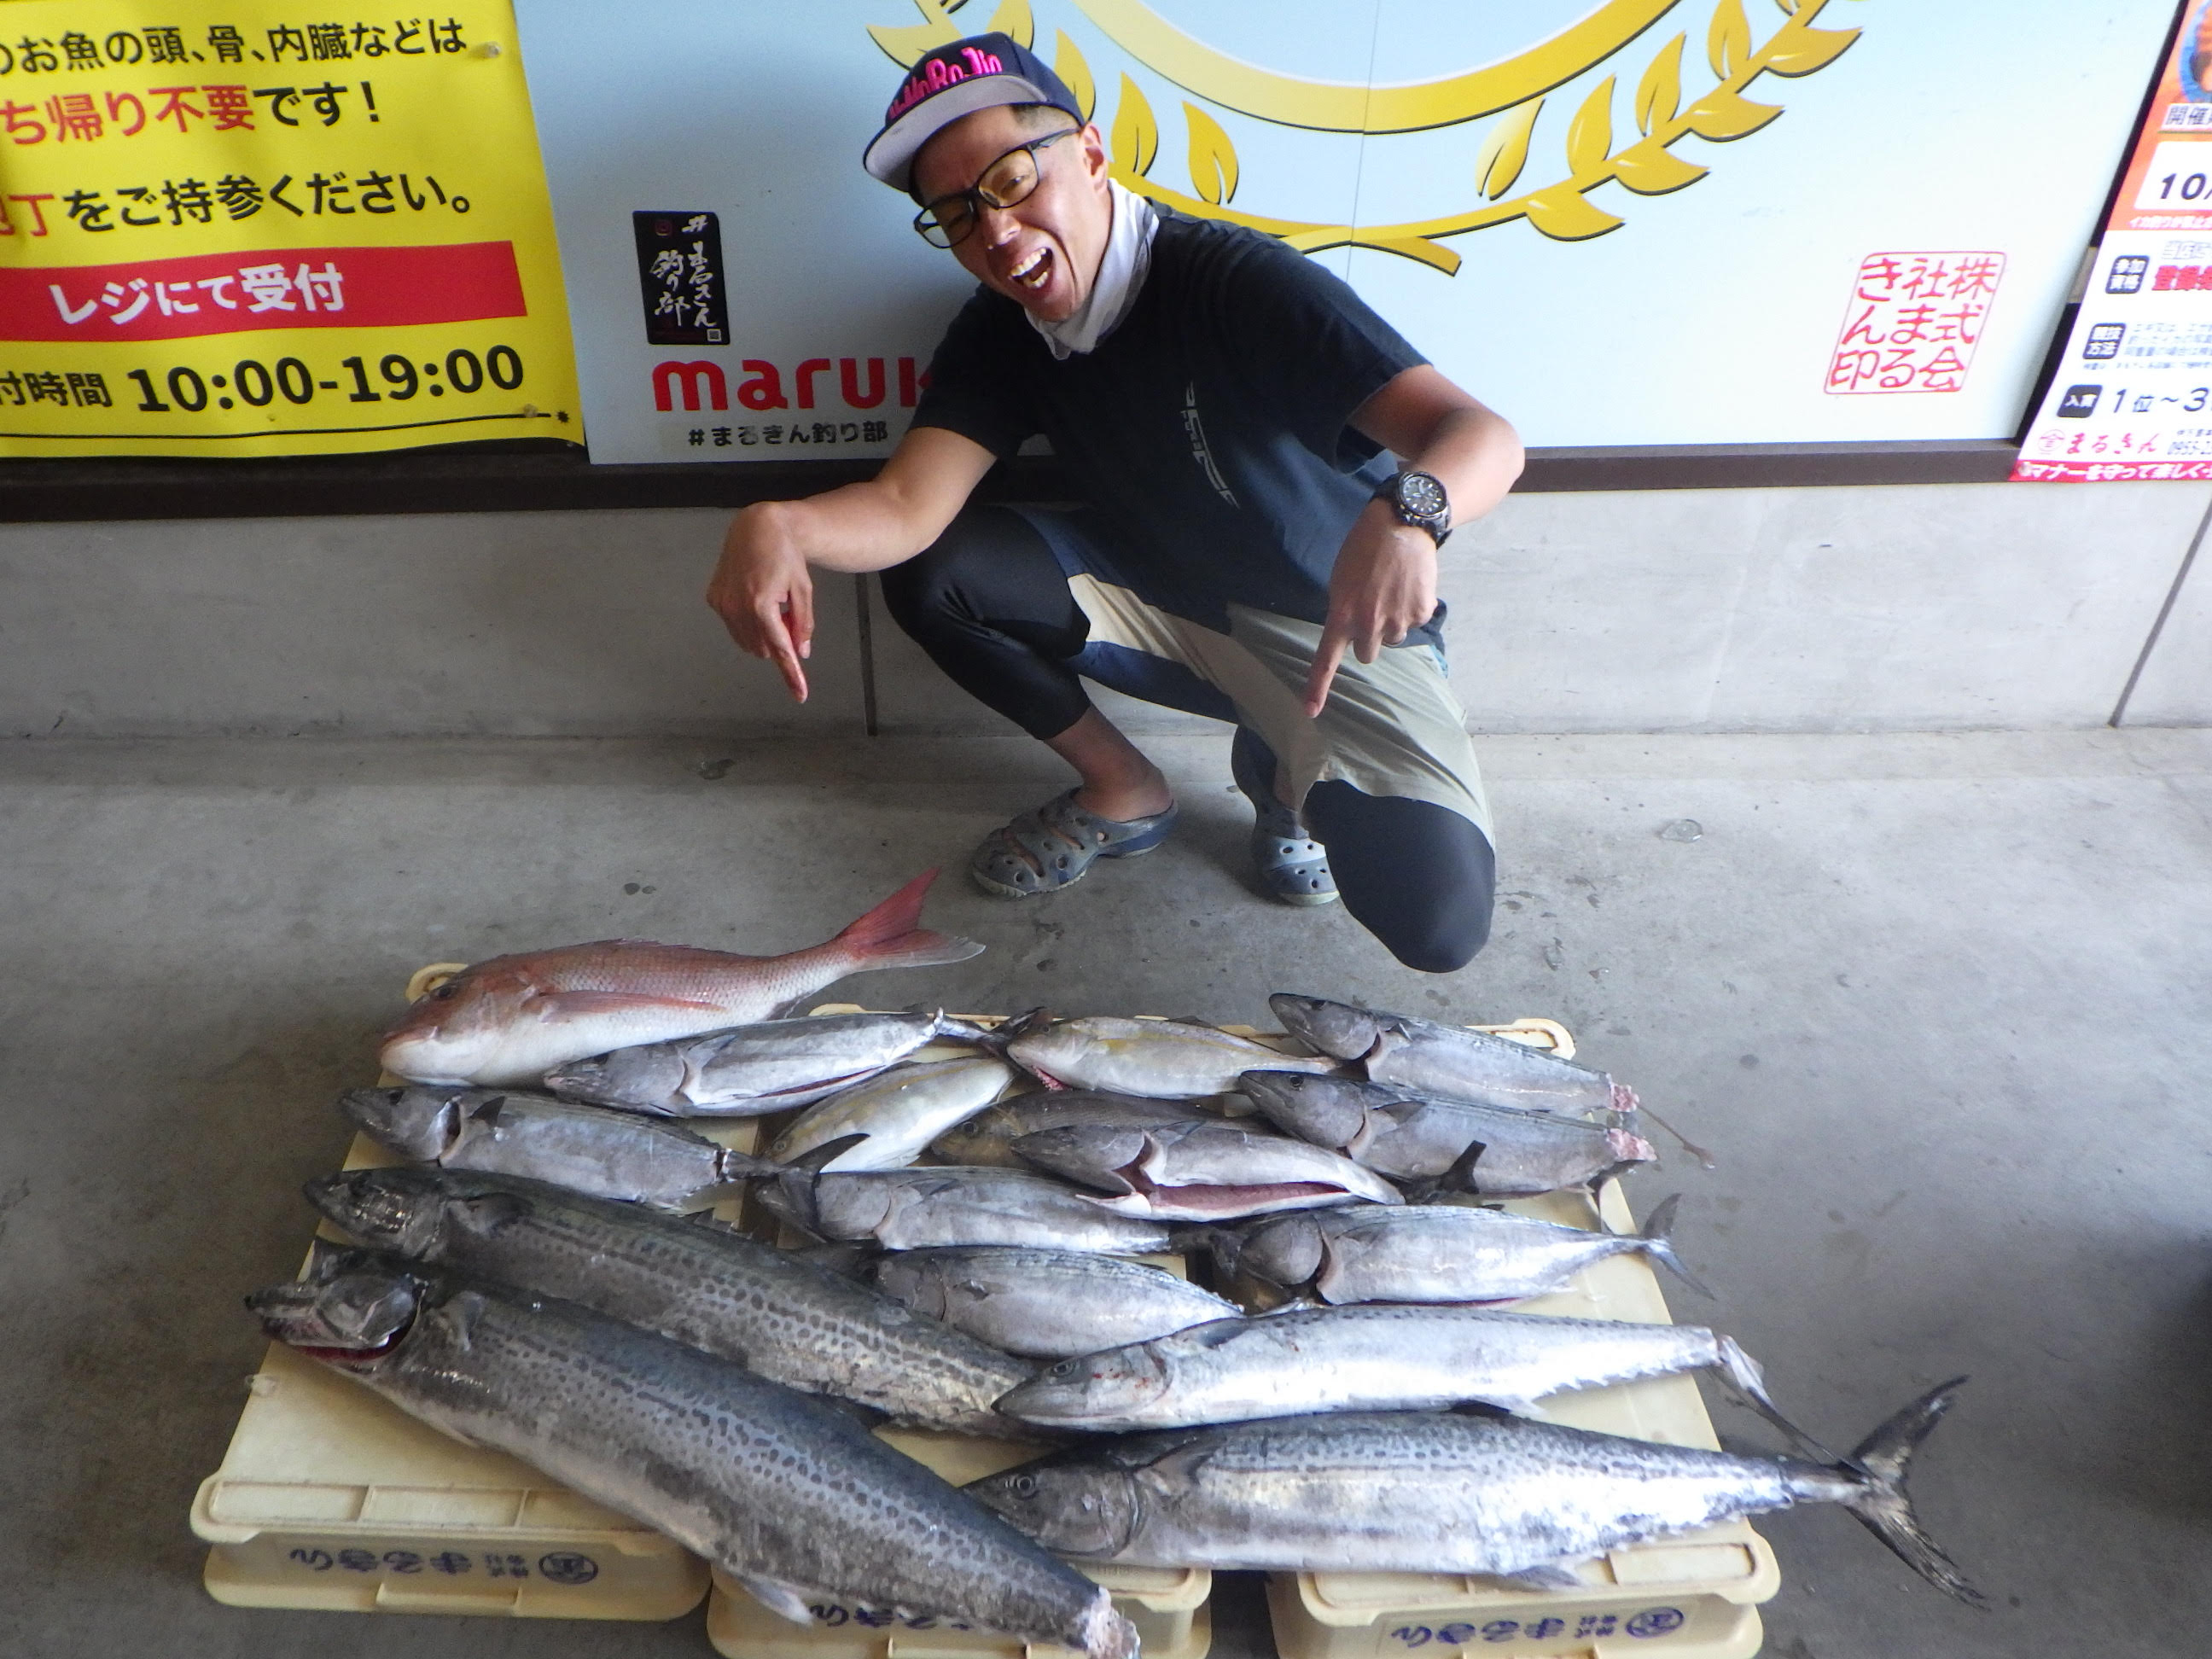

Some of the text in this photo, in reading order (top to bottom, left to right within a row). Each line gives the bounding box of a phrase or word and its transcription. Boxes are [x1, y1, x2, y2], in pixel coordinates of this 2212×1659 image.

[49, 262, 344, 325] レジにて受付
[127, 345, 523, 412] 10:00-19:00
